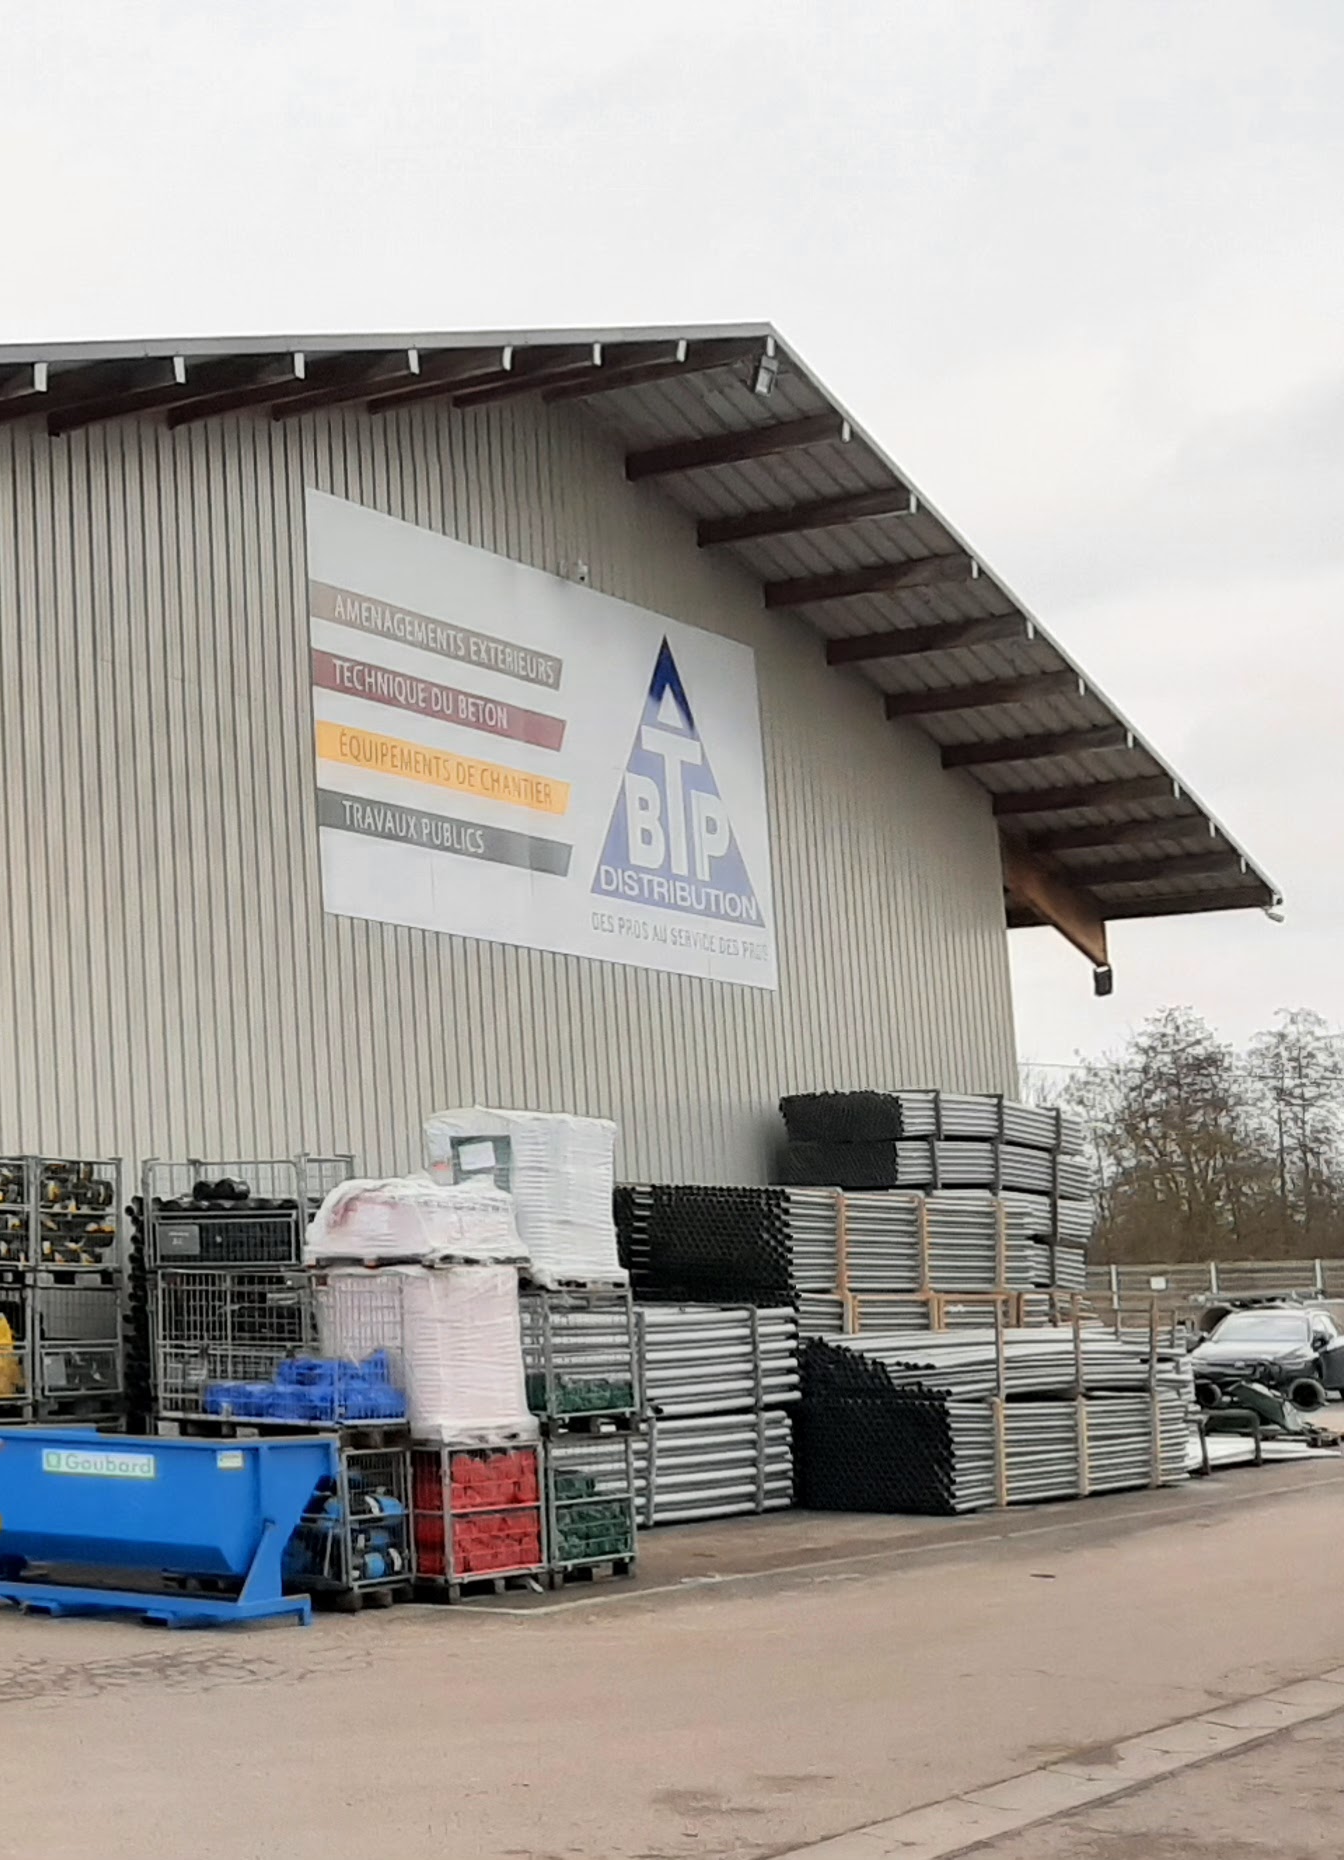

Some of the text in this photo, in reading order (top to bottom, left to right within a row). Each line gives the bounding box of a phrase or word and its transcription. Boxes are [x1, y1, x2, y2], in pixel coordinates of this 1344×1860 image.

[334, 595, 555, 685] AMENAGEMENTS EXTERIEURS
[332, 659, 510, 729] TECHNIQUE DU BETON
[339, 732, 553, 805] ÉQUIPEMENTS DE CHANTIER
[342, 800, 486, 854] TRAVAUX PUBLICS
[600, 866, 758, 921] DISTRIBUTION
[592, 912, 615, 934] DES
[618, 916, 649, 941] PROS
[652, 925, 668, 944] AU
[671, 927, 716, 953] SERVICE
[719, 937, 740, 956] DES
[65, 1453, 153, 1475] Goubard
